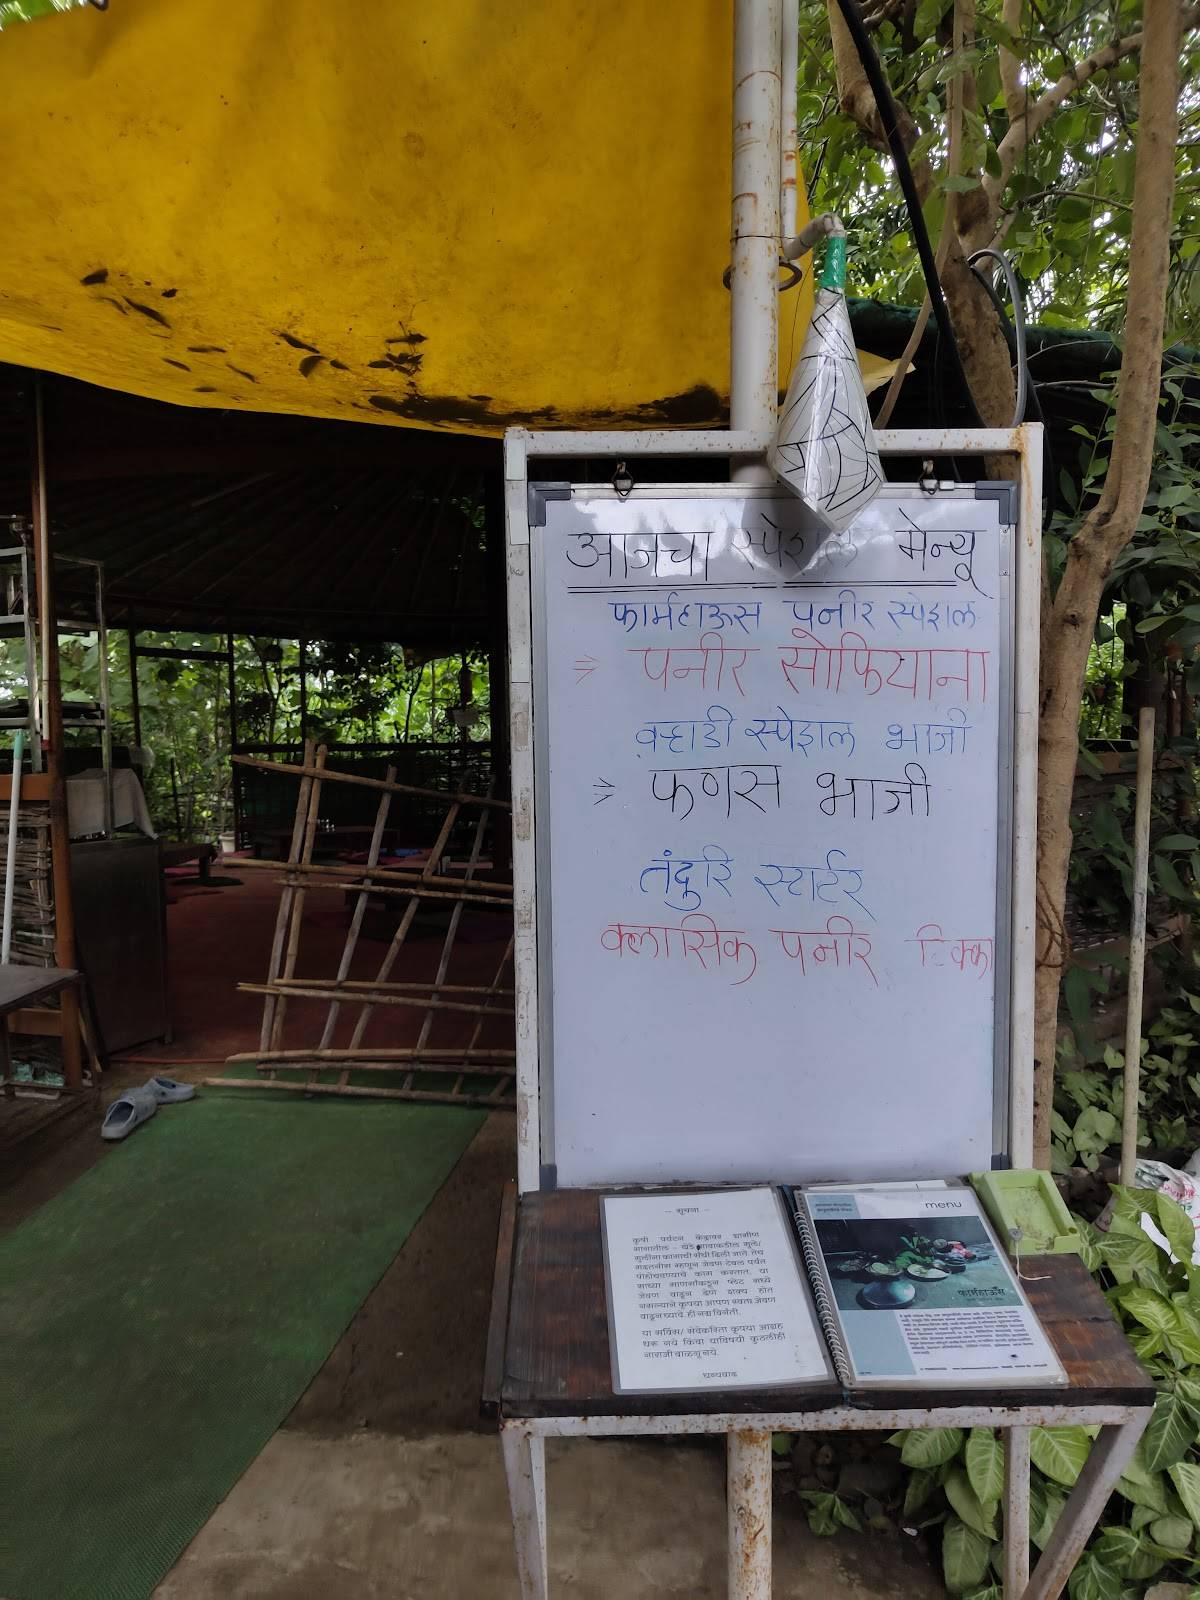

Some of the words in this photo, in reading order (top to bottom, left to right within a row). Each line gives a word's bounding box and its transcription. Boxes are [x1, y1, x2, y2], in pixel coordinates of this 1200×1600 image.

[566, 532, 714, 581] आजचा
[783, 589, 875, 631] पनीर
[627, 631, 760, 696] पनीर
[886, 707, 974, 758] भाजी
[649, 764, 782, 821] फणस
[816, 762, 932, 821] भाजी
[768, 915, 878, 987] पनीर
[904, 923, 993, 980] िक्का
[925, 1200, 962, 1210] menu
